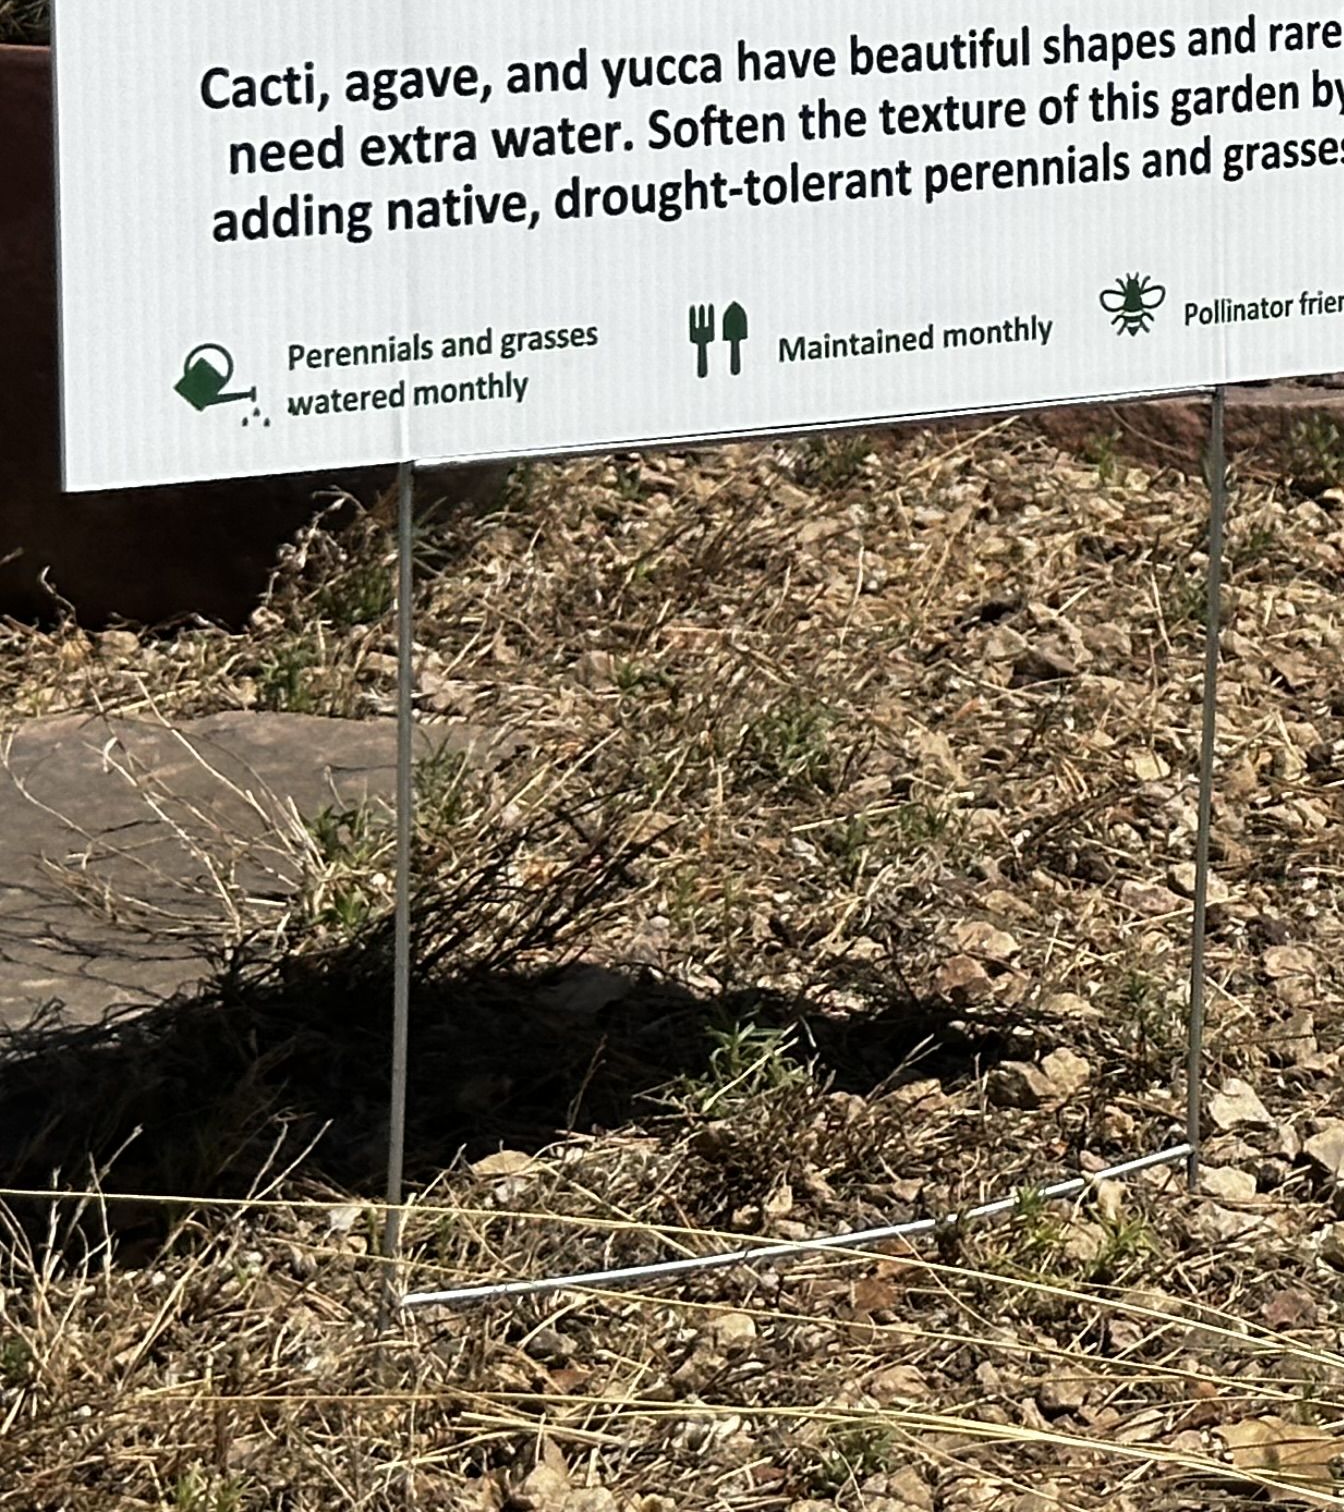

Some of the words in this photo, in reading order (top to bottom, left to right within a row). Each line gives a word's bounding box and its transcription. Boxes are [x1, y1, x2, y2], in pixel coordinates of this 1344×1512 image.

[200, 61, 330, 113] Cacti,
[345, 64, 492, 111] agave,
[506, 47, 588, 94] and
[600, 52, 722, 100] yucca
[737, 39, 836, 82] have
[850, 25, 1030, 76] beautiful
[1043, 23, 1176, 71] shapes
[1187, 13, 1256, 57] and
[229, 124, 344, 175] need
[360, 125, 477, 167] extra
[490, 117, 634, 159] water.
[648, 103, 786, 150] Soften
[797, 97, 867, 141] the
[878, 95, 1027, 136] texture
[1038, 83, 1080, 126] of
[1088, 80, 1160, 123] this
[1170, 72, 1300, 127] garden
[212, 193, 373, 244] adding
[387, 183, 540, 231] native,
[554, 159, 913, 223] drought-tolerant
[925, 141, 1130, 205] perennials
[1141, 134, 1212, 179] and
[1184, 297, 1294, 327] Pollinator
[288, 332, 434, 371] Perennials
[441, 326, 493, 359] and
[500, 326, 599, 360] grasses
[779, 323, 934, 363] Maintained
[943, 314, 1053, 349] monthly
[287, 379, 405, 417] watered
[413, 370, 529, 407] monthly
